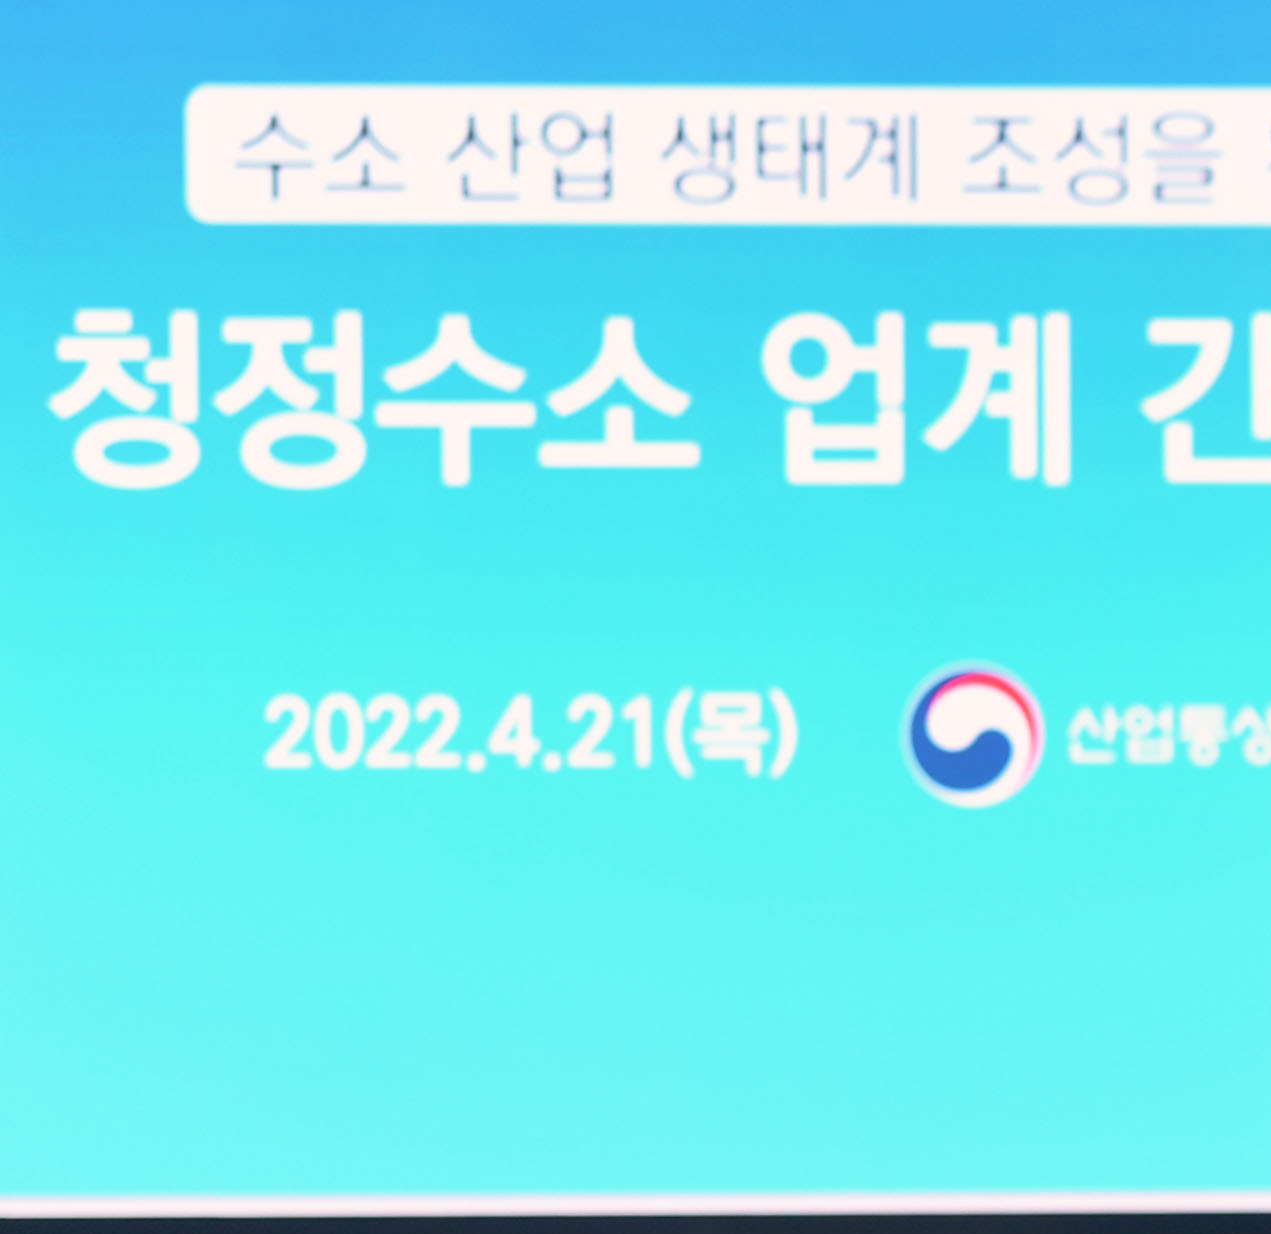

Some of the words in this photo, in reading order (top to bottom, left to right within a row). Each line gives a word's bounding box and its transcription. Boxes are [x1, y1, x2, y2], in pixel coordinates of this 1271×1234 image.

[234, 111, 404, 203] 수소
[446, 109, 617, 204] 산업
[661, 108, 920, 205] 생태계
[963, 109, 1222, 207] 조성을
[46, 306, 702, 490] 청정수소
[759, 308, 1073, 490] 업계
[262, 687, 799, 780] 2022.4.21(목)
